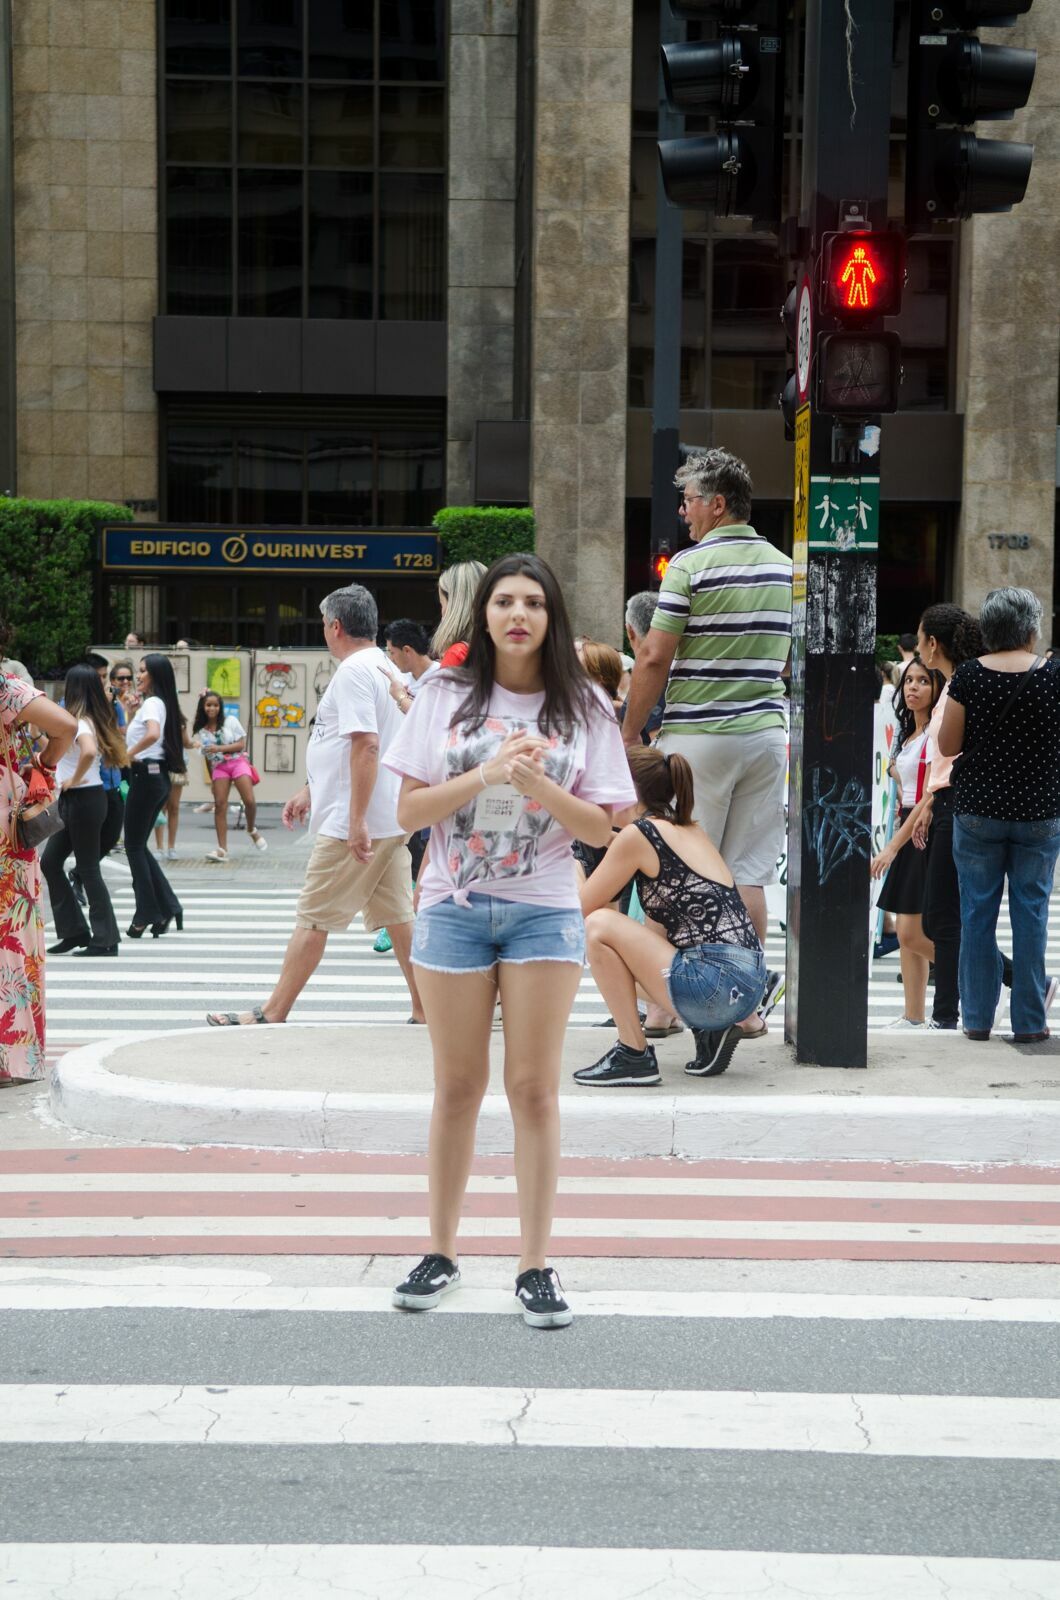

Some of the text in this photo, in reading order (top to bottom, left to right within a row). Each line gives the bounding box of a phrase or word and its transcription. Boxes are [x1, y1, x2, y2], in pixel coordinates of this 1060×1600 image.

[988, 533, 1031, 550] 1708
[130, 540, 211, 557] EDIFICIO
[252, 542, 367, 560] OURINVEST
[393, 553, 433, 567] 1728
